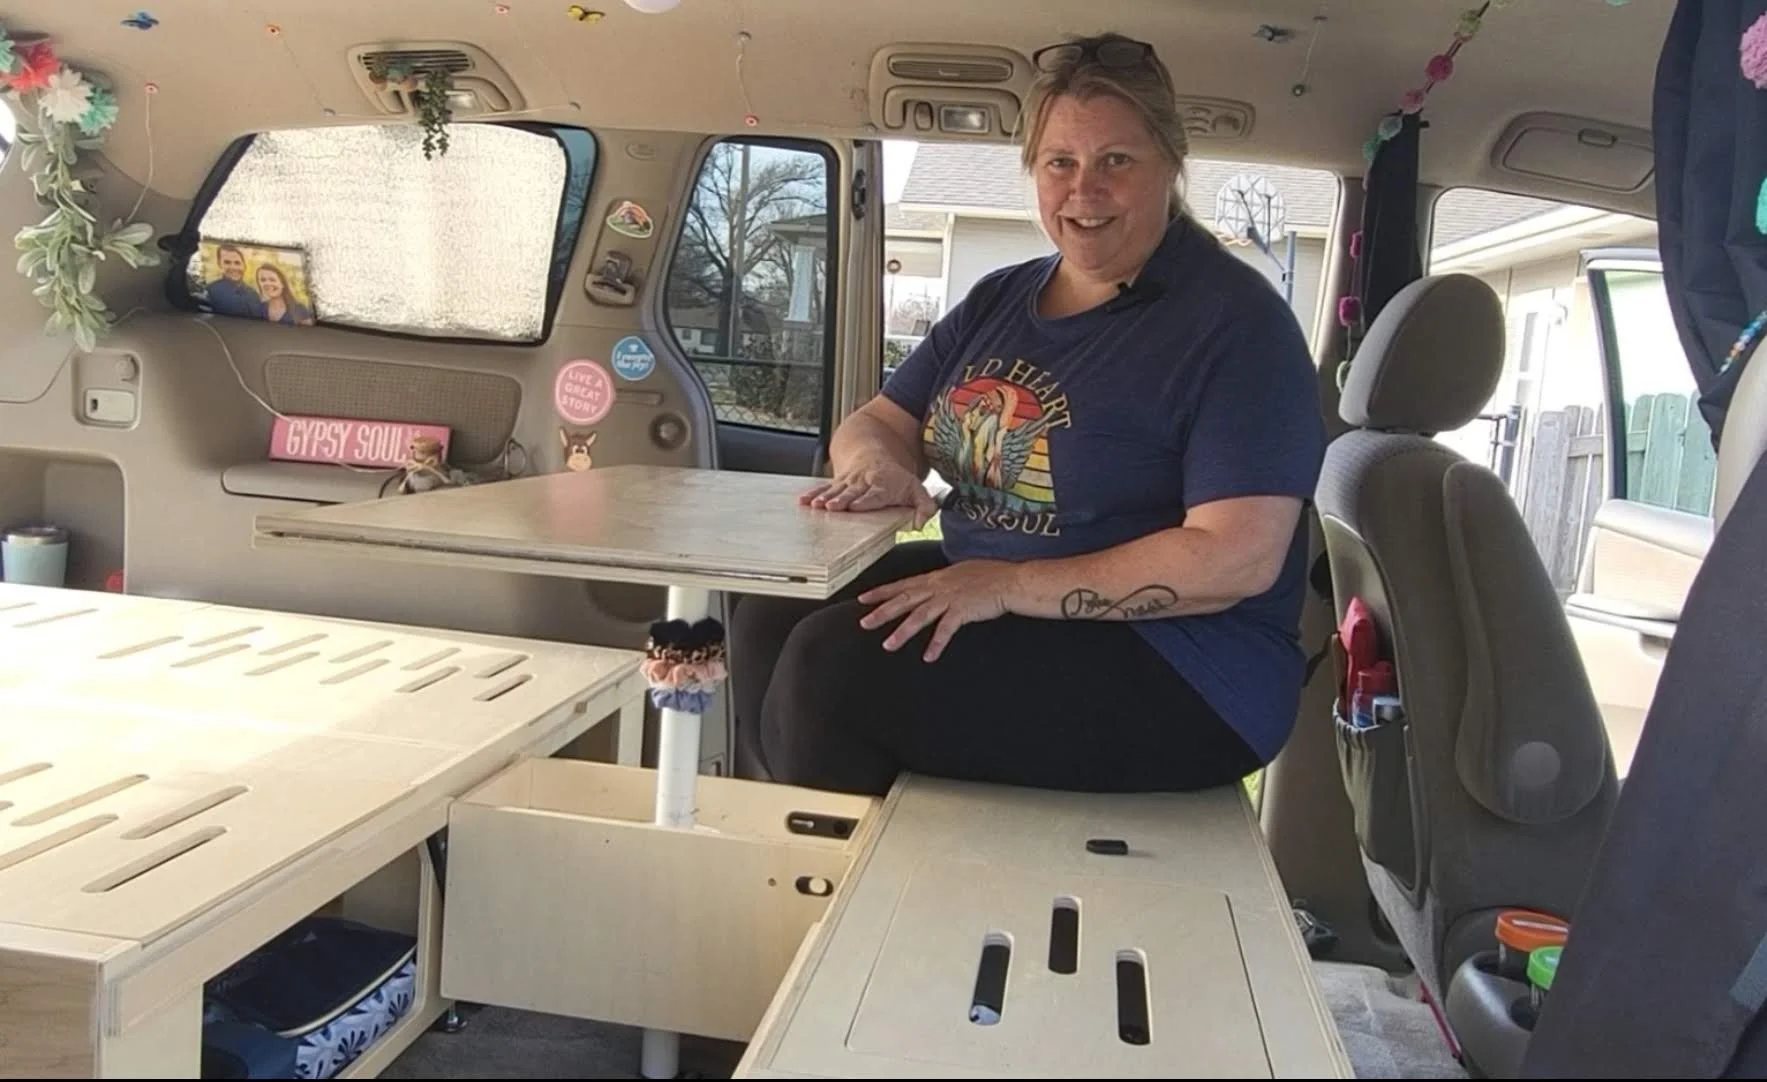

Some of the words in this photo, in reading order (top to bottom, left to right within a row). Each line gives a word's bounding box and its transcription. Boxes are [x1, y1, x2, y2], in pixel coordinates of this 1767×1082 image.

[568, 370, 593, 387] LIVE
[594, 378, 603, 390] A
[564, 382, 601, 401] GREAT
[1004, 359, 1072, 429] HEART
[560, 394, 599, 414] STORY
[285, 418, 354, 460] GYPSY
[353, 425, 407, 464] SOUL
